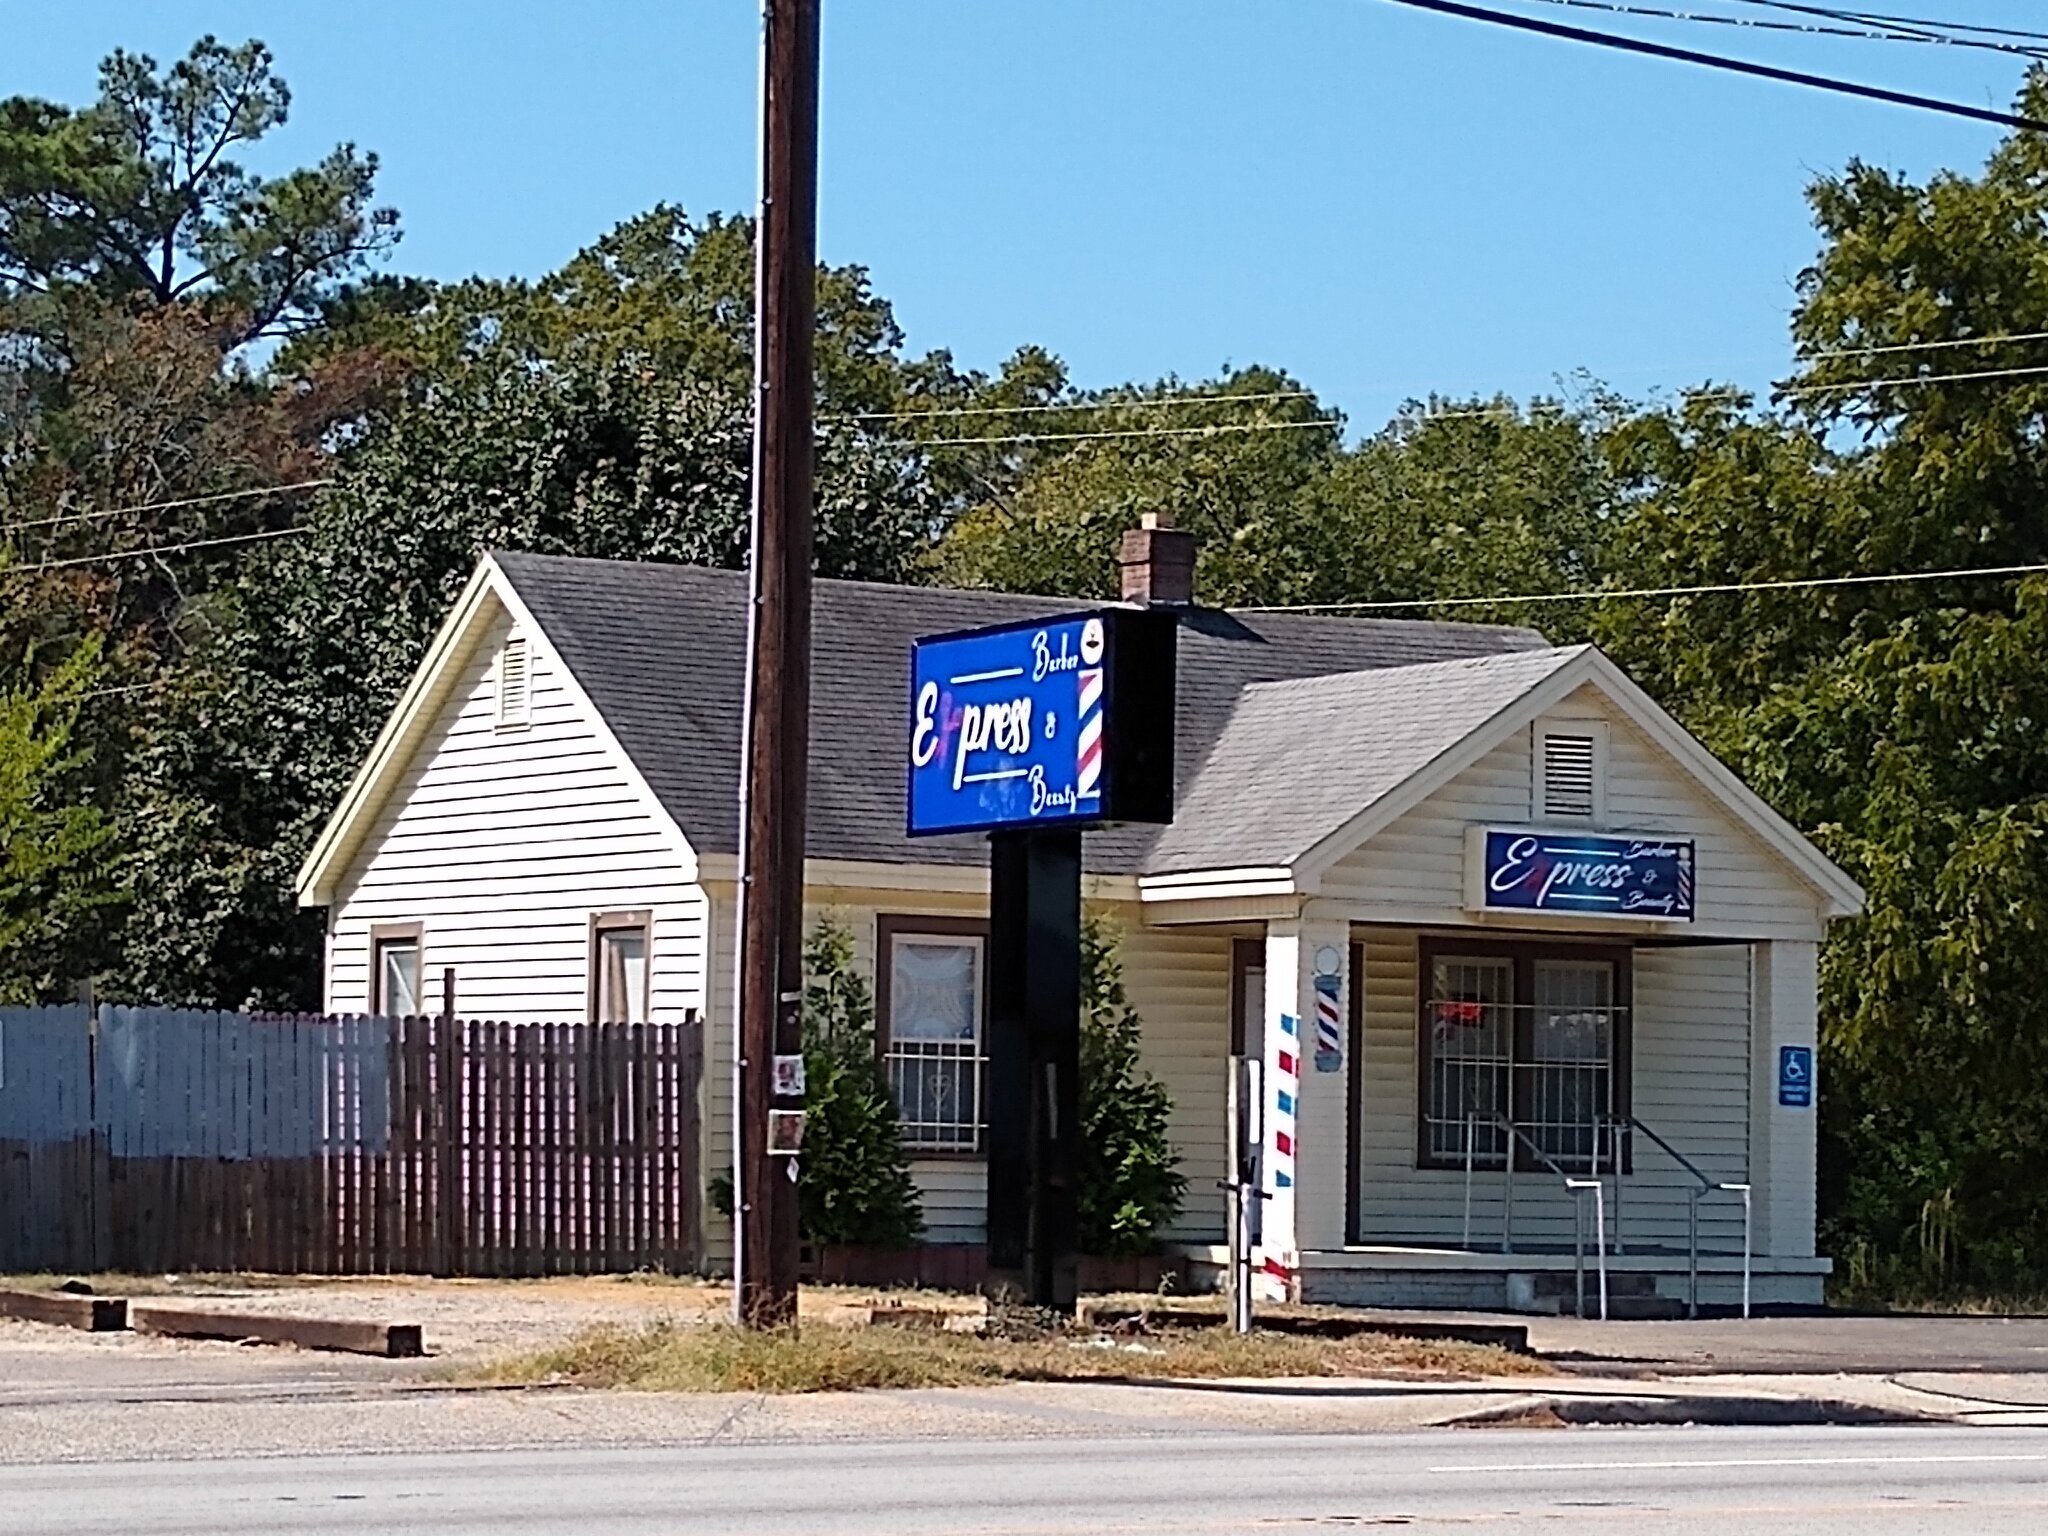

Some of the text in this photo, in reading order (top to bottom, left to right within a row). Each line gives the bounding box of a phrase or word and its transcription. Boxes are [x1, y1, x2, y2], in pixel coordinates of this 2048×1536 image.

[1031, 630, 1079, 682] Barber
[1623, 840, 1676, 860] Barber
[1642, 871, 1657, 886] &
[1622, 890, 1675, 914] Beauty
